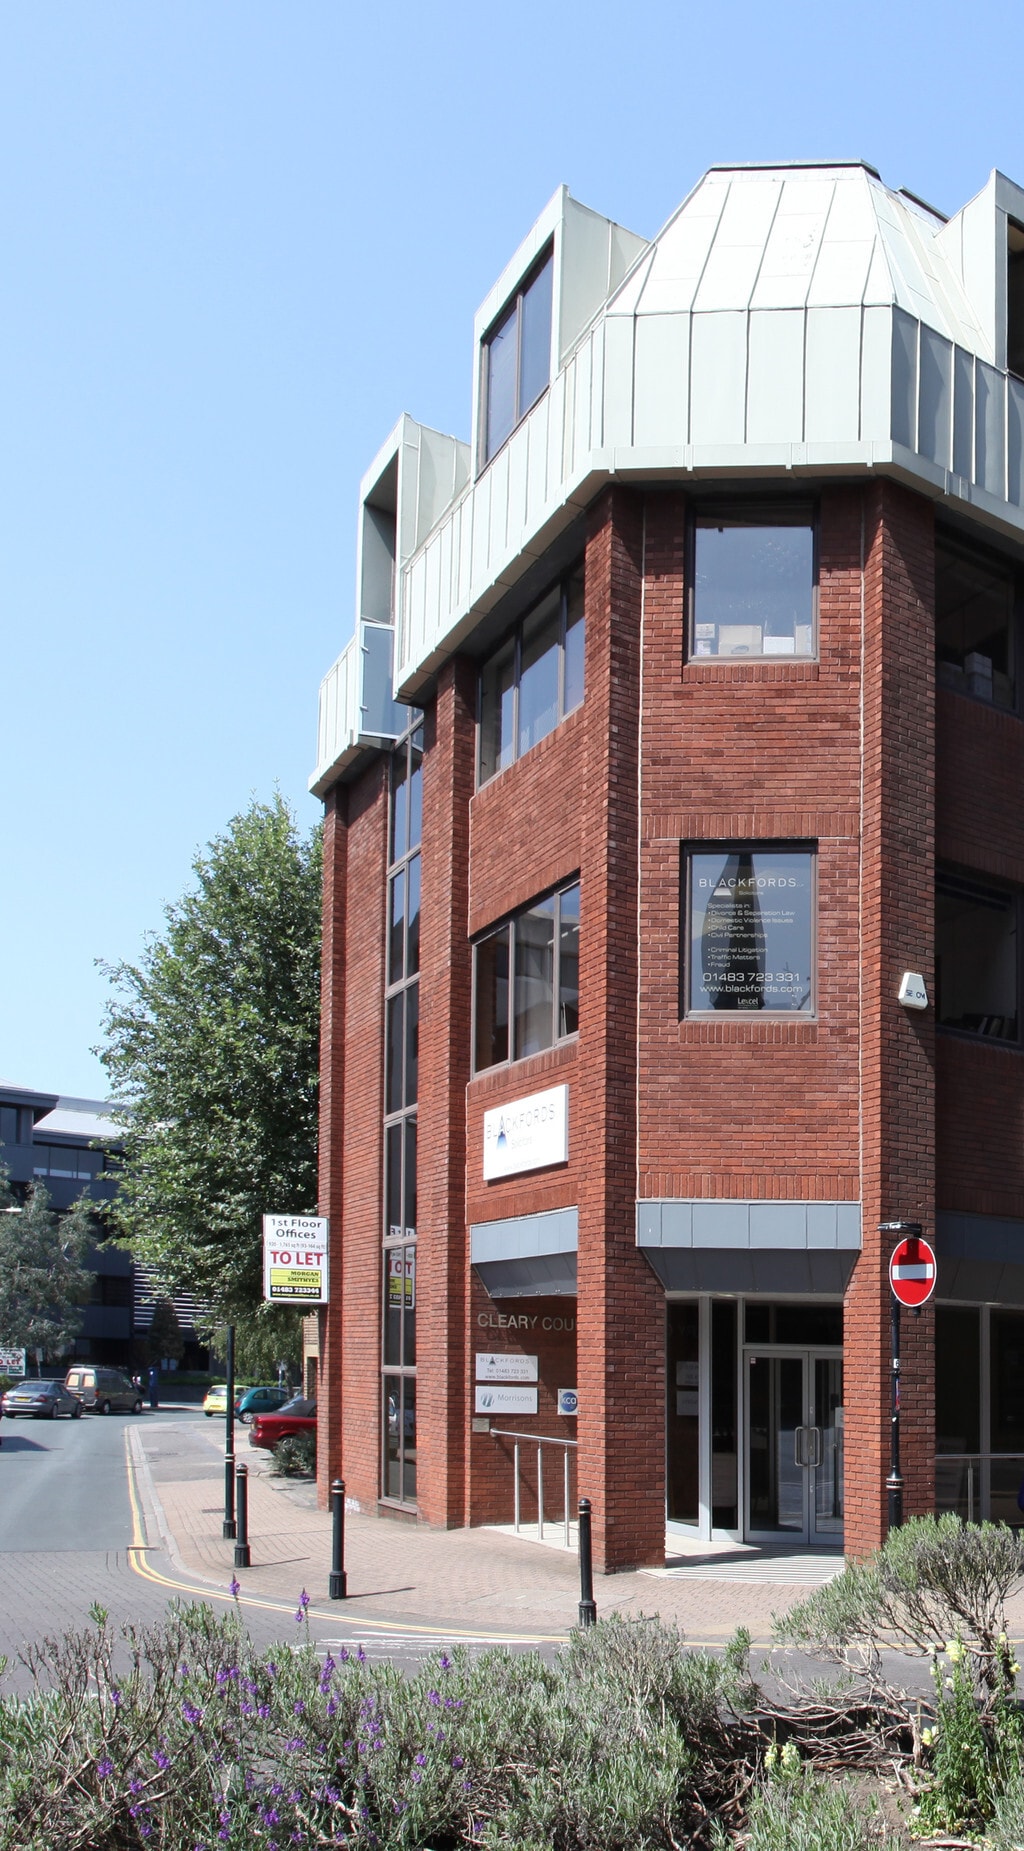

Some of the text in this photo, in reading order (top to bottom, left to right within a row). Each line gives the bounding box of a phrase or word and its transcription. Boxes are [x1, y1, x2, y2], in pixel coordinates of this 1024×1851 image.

[699, 878, 797, 887] BLACKFORDS
[702, 973, 800, 982] 01483 723 331
[699, 984, 803, 993] www.blackfords.com
[487, 1104, 555, 1139] BLACKFORDS
[271, 1218, 321, 1229] 1st Floor
[276, 1228, 316, 1239] Offices
[270, 1250, 324, 1266] TO LET
[477, 1313, 538, 1330] CLEARY
[480, 1356, 530, 1365] BLACKFORDS
[497, 1394, 533, 1402] Morrisons
